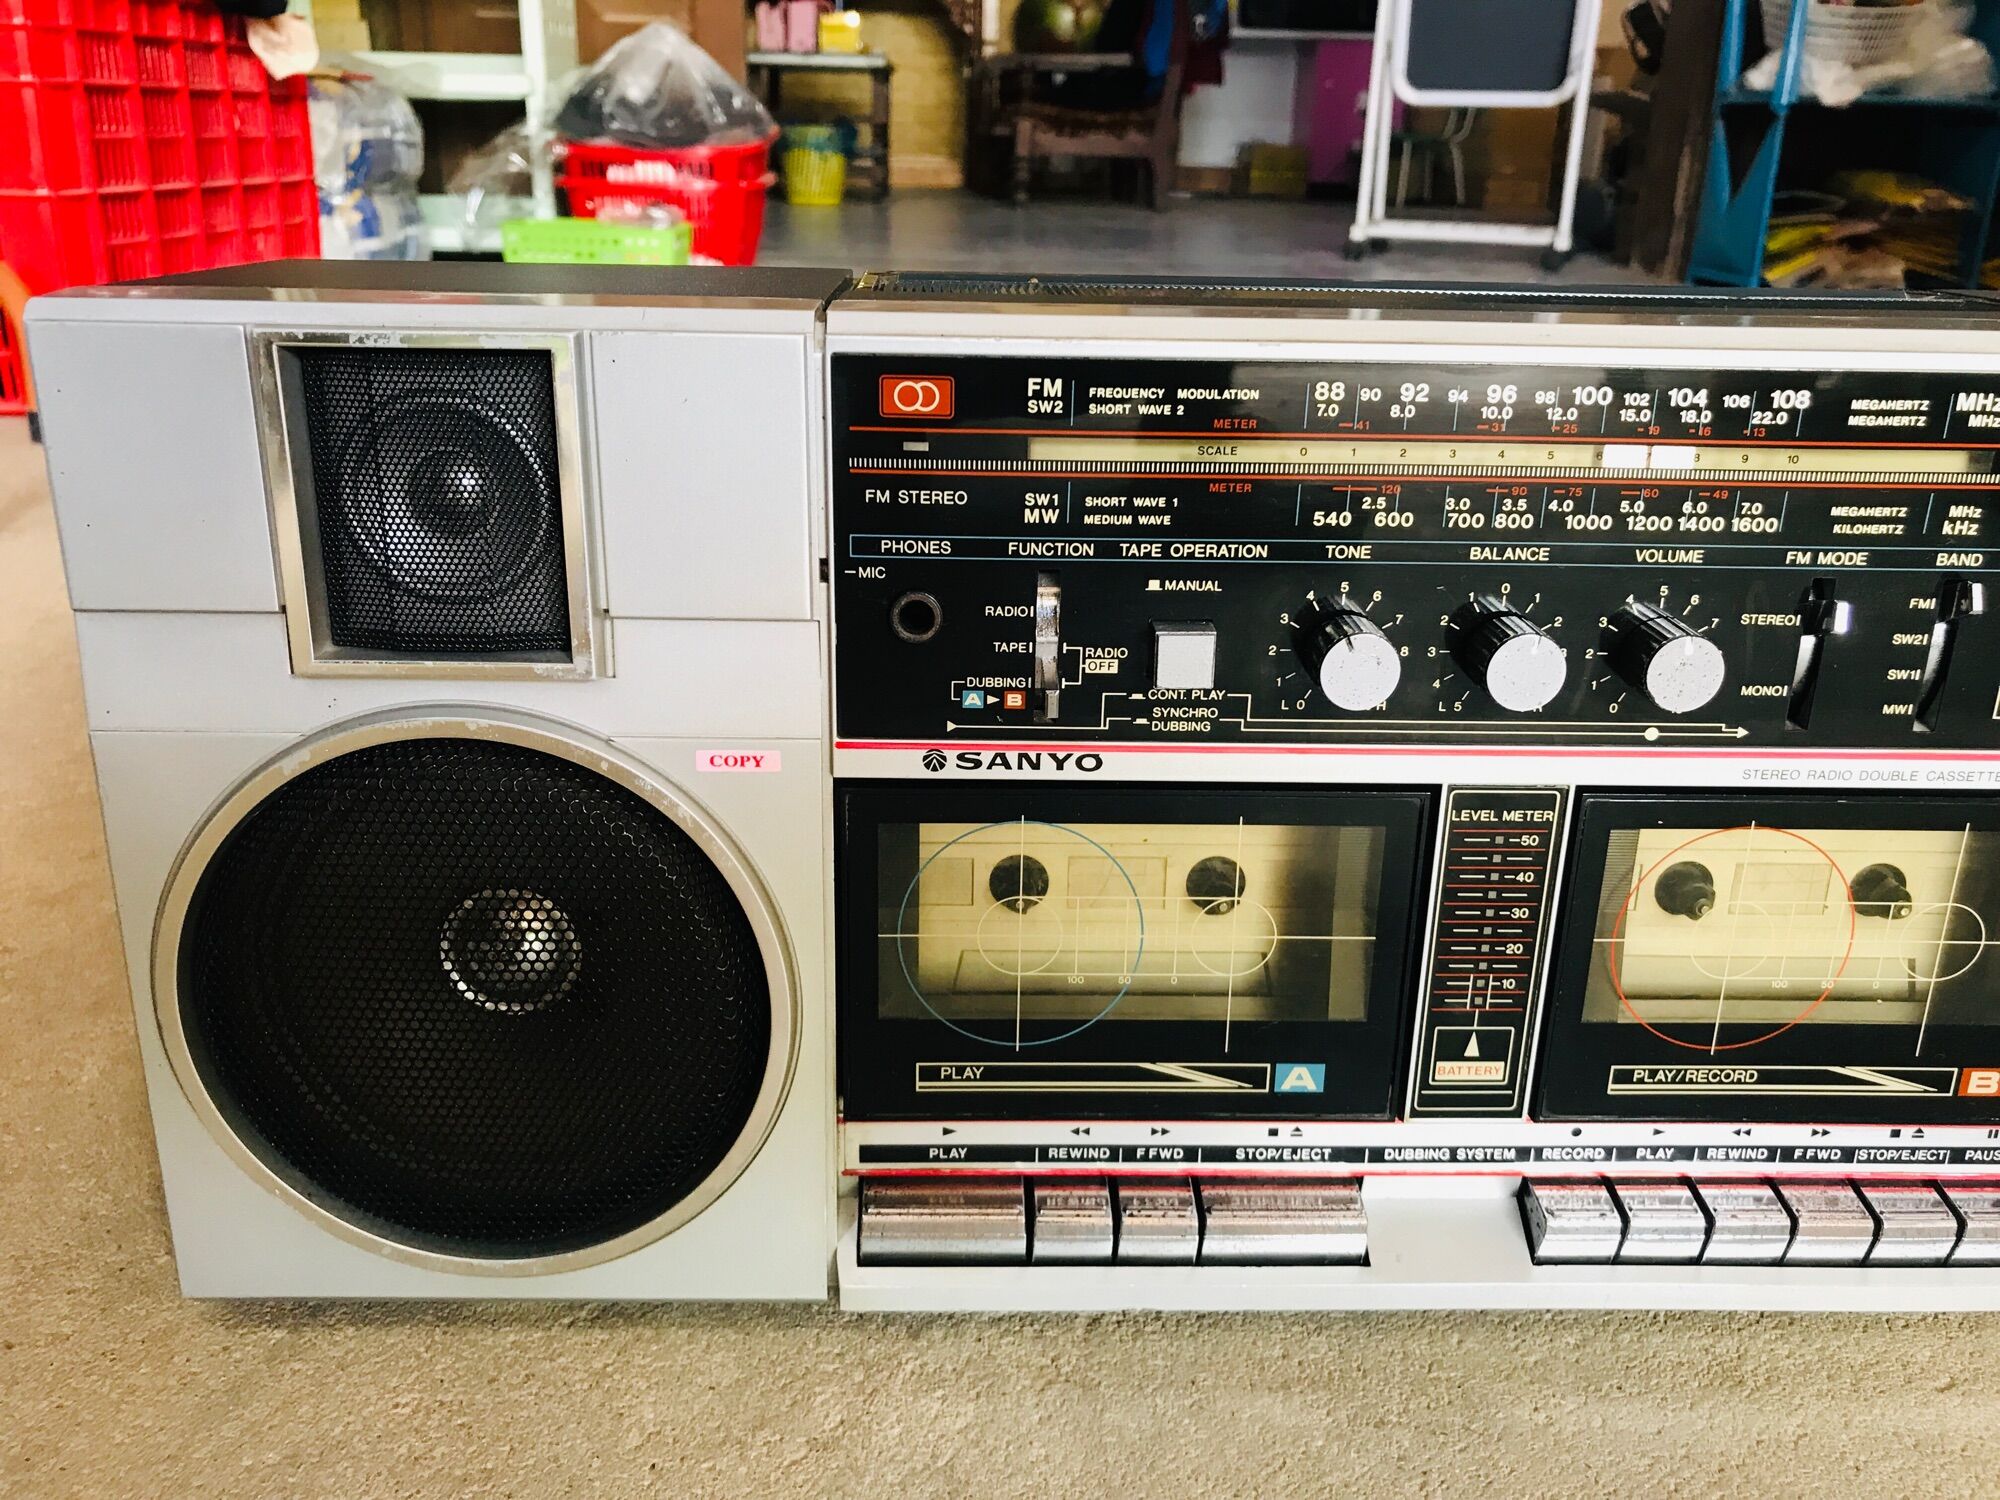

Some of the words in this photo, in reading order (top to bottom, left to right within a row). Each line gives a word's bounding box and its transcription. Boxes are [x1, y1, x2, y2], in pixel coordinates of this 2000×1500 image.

[1027, 378, 1062, 396] FM
[1089, 388, 1164, 399] FREQUENCY
[1177, 389, 1259, 400] MODULATION
[1314, 382, 1345, 401] 88
[1360, 389, 1381, 401] 90
[1400, 383, 1429, 402] 92
[1448, 390, 1468, 403] 94
[1487, 385, 1517, 403] 96
[1535, 391, 1555, 404] 98
[1572, 387, 1613, 405] 100
[1624, 393, 1649, 406] 102
[1668, 388, 1708, 407] 104
[1723, 395, 1750, 408] 106
[1771, 390, 1811, 409] 108
[1027, 401, 1063, 413] SW2
[1851, 400, 1929, 411] MEGAHERTZ
[1956, 393, 2000, 411] MHz
[1089, 404, 1130, 414] SHORT
[1138, 405, 1172, 415] WAVE
[1177, 405, 1184, 415] 2
[1317, 404, 1338, 417] 7.0
[1390, 405, 1415, 417] 8.0
[1481, 407, 1513, 419] 10.0
[1546, 408, 1577, 420] 12.0
[1620, 410, 1650, 422] 15.0
[1680, 410, 1711, 423] 18.0
[1752, 412, 1788, 424] 22.0
[1214, 419, 1256, 428] METER
[1848, 416, 1926, 426] MEGAHERTZ
[1968, 415, 2000, 427] MHz
[1197, 446, 1237, 456] SCALE
[1300, 448, 1307, 456] 0
[1400, 448, 1406, 457] 2
[1450, 450, 1456, 458] 3
[1498, 450, 1504, 459] 4
[1548, 451, 1554, 459] 5
[1742, 455, 1748, 463] 9
[1788, 455, 1798, 464] 10
[1209, 483, 1252, 492] METER
[865, 490, 890, 503] FM
[898, 491, 967, 504] STEREO
[1025, 494, 1059, 506] SW1
[1085, 497, 1126, 507] SHORT
[1133, 498, 1167, 507] WAVE
[1362, 497, 1386, 510] 2.5
[1445, 498, 1470, 510] 3.0
[1502, 499, 1527, 511] 3.5
[1548, 500, 1573, 512] 4.0
[1620, 501, 1644, 512] 5.0
[1682, 502, 1707, 513] 6.0
[1741, 502, 1762, 514] 7.0
[1024, 509, 1059, 523] MW
[1831, 506, 1908, 517] MEGAHERTZ
[1949, 506, 1982, 517] MHz
[1084, 515, 1132, 525] MEDIUM
[1138, 515, 1171, 525] WAVE
[1313, 512, 1351, 526] 540
[1374, 512, 1413, 527] 600
[1447, 513, 1484, 528] 700
[1495, 514, 1534, 529] 800
[1565, 515, 1612, 530] 1000
[1626, 517, 1672, 530] 1200
[1678, 517, 1724, 531] 1400
[1732, 518, 1778, 532] 1600
[1833, 524, 1903, 534] KILOHERTZ
[1942, 521, 1979, 535] kHz
[881, 540, 951, 554] PHONES
[1008, 542, 1094, 556] FUNCTION
[1120, 543, 1161, 556] TAPE
[1170, 544, 1267, 558] OPERATION
[1326, 545, 1372, 558] TONE
[1470, 547, 1550, 561] BALANCE
[1635, 549, 1704, 564] VOLUME
[1786, 552, 1813, 565] FM
[1818, 552, 1868, 566] MODE
[1936, 553, 1983, 566] BAND
[1165, 580, 1222, 592] MANUAL
[1341, 582, 1349, 592] 5
[1502, 583, 1510, 594] 0
[1660, 585, 1668, 596] 5
[1306, 590, 1314, 601] 4
[1373, 591, 1382, 602] 6
[1691, 595, 1699, 605] 6
[1910, 598, 1932, 609] FM
[985, 606, 1028, 617] RADIO
[1280, 614, 1288, 624] 3
[1396, 614, 1403, 625] 7
[1440, 616, 1448, 626] 2
[1554, 617, 1562, 627] 2
[1599, 617, 1607, 627] 3
[1712, 618, 1719, 628] 7
[1741, 614, 1797, 626] STEREO
[1892, 634, 1923, 645] SW2
[993, 643, 1026, 653] TAPE
[1085, 648, 1128, 659] RADIO
[1269, 646, 1276, 656] 2
[1400, 646, 1408, 656] 8
[1428, 647, 1436, 657] 3
[1585, 649, 1593, 658] 2
[1088, 662, 1115, 671] OFF
[1887, 669, 1916, 680] SW1
[967, 677, 1026, 688] DUBBING
[1432, 679, 1440, 688] 4
[1592, 681, 1596, 690] 1
[1148, 690, 1188, 701] CONT.
[1191, 690, 1225, 701] PLAY
[1741, 685, 1782, 696] MONO
[964, 693, 982, 706] A
[1007, 694, 1023, 706] B
[1281, 700, 1288, 710] L
[1297, 700, 1305, 710] 0
[1153, 707, 1218, 718] SYNCHRO
[1439, 702, 1446, 712] L
[1454, 702, 1462, 712] 5
[1609, 703, 1618, 713] 0
[1882, 704, 1908, 715] MW
[1152, 721, 1211, 731] DUBBING
[710, 755, 764, 768] COPY
[956, 753, 1103, 772] SANYO
[1742, 769, 1800, 780] STEREO
[1807, 770, 1852, 781] RADIO
[1859, 770, 1918, 782] DOUBLE
[1452, 810, 1498, 821] LEVEL
[1503, 811, 1553, 821] METER
[1521, 835, 1539, 846] 50
[1516, 872, 1534, 882] 40
[1511, 908, 1529, 918] 30
[1506, 944, 1523, 954] 20
[1067, 976, 1084, 984] 100
[1118, 976, 1131, 984] 50
[1501, 979, 1515, 989] 10
[941, 1067, 984, 1079] PLAY
[1438, 1066, 1501, 1076] BATTERY
[1633, 1069, 1758, 1083] PLAY/RECORD
[1280, 1067, 1317, 1090] A
[1967, 1072, 2000, 1093] B
[929, 1148, 967, 1159] PLAY
[1048, 1148, 1110, 1159] REWIND
[1236, 1148, 1332, 1161] STOP/EJECT
[1385, 1149, 1450, 1160] DUBBING
[1456, 1149, 1515, 1160] SYSTEM
[1542, 1148, 1605, 1159] RECORD
[1636, 1148, 1674, 1160] PLAY
[1707, 1148, 1768, 1160] REWIND
[1858, 1149, 1946, 1162] STOP/EJECT
